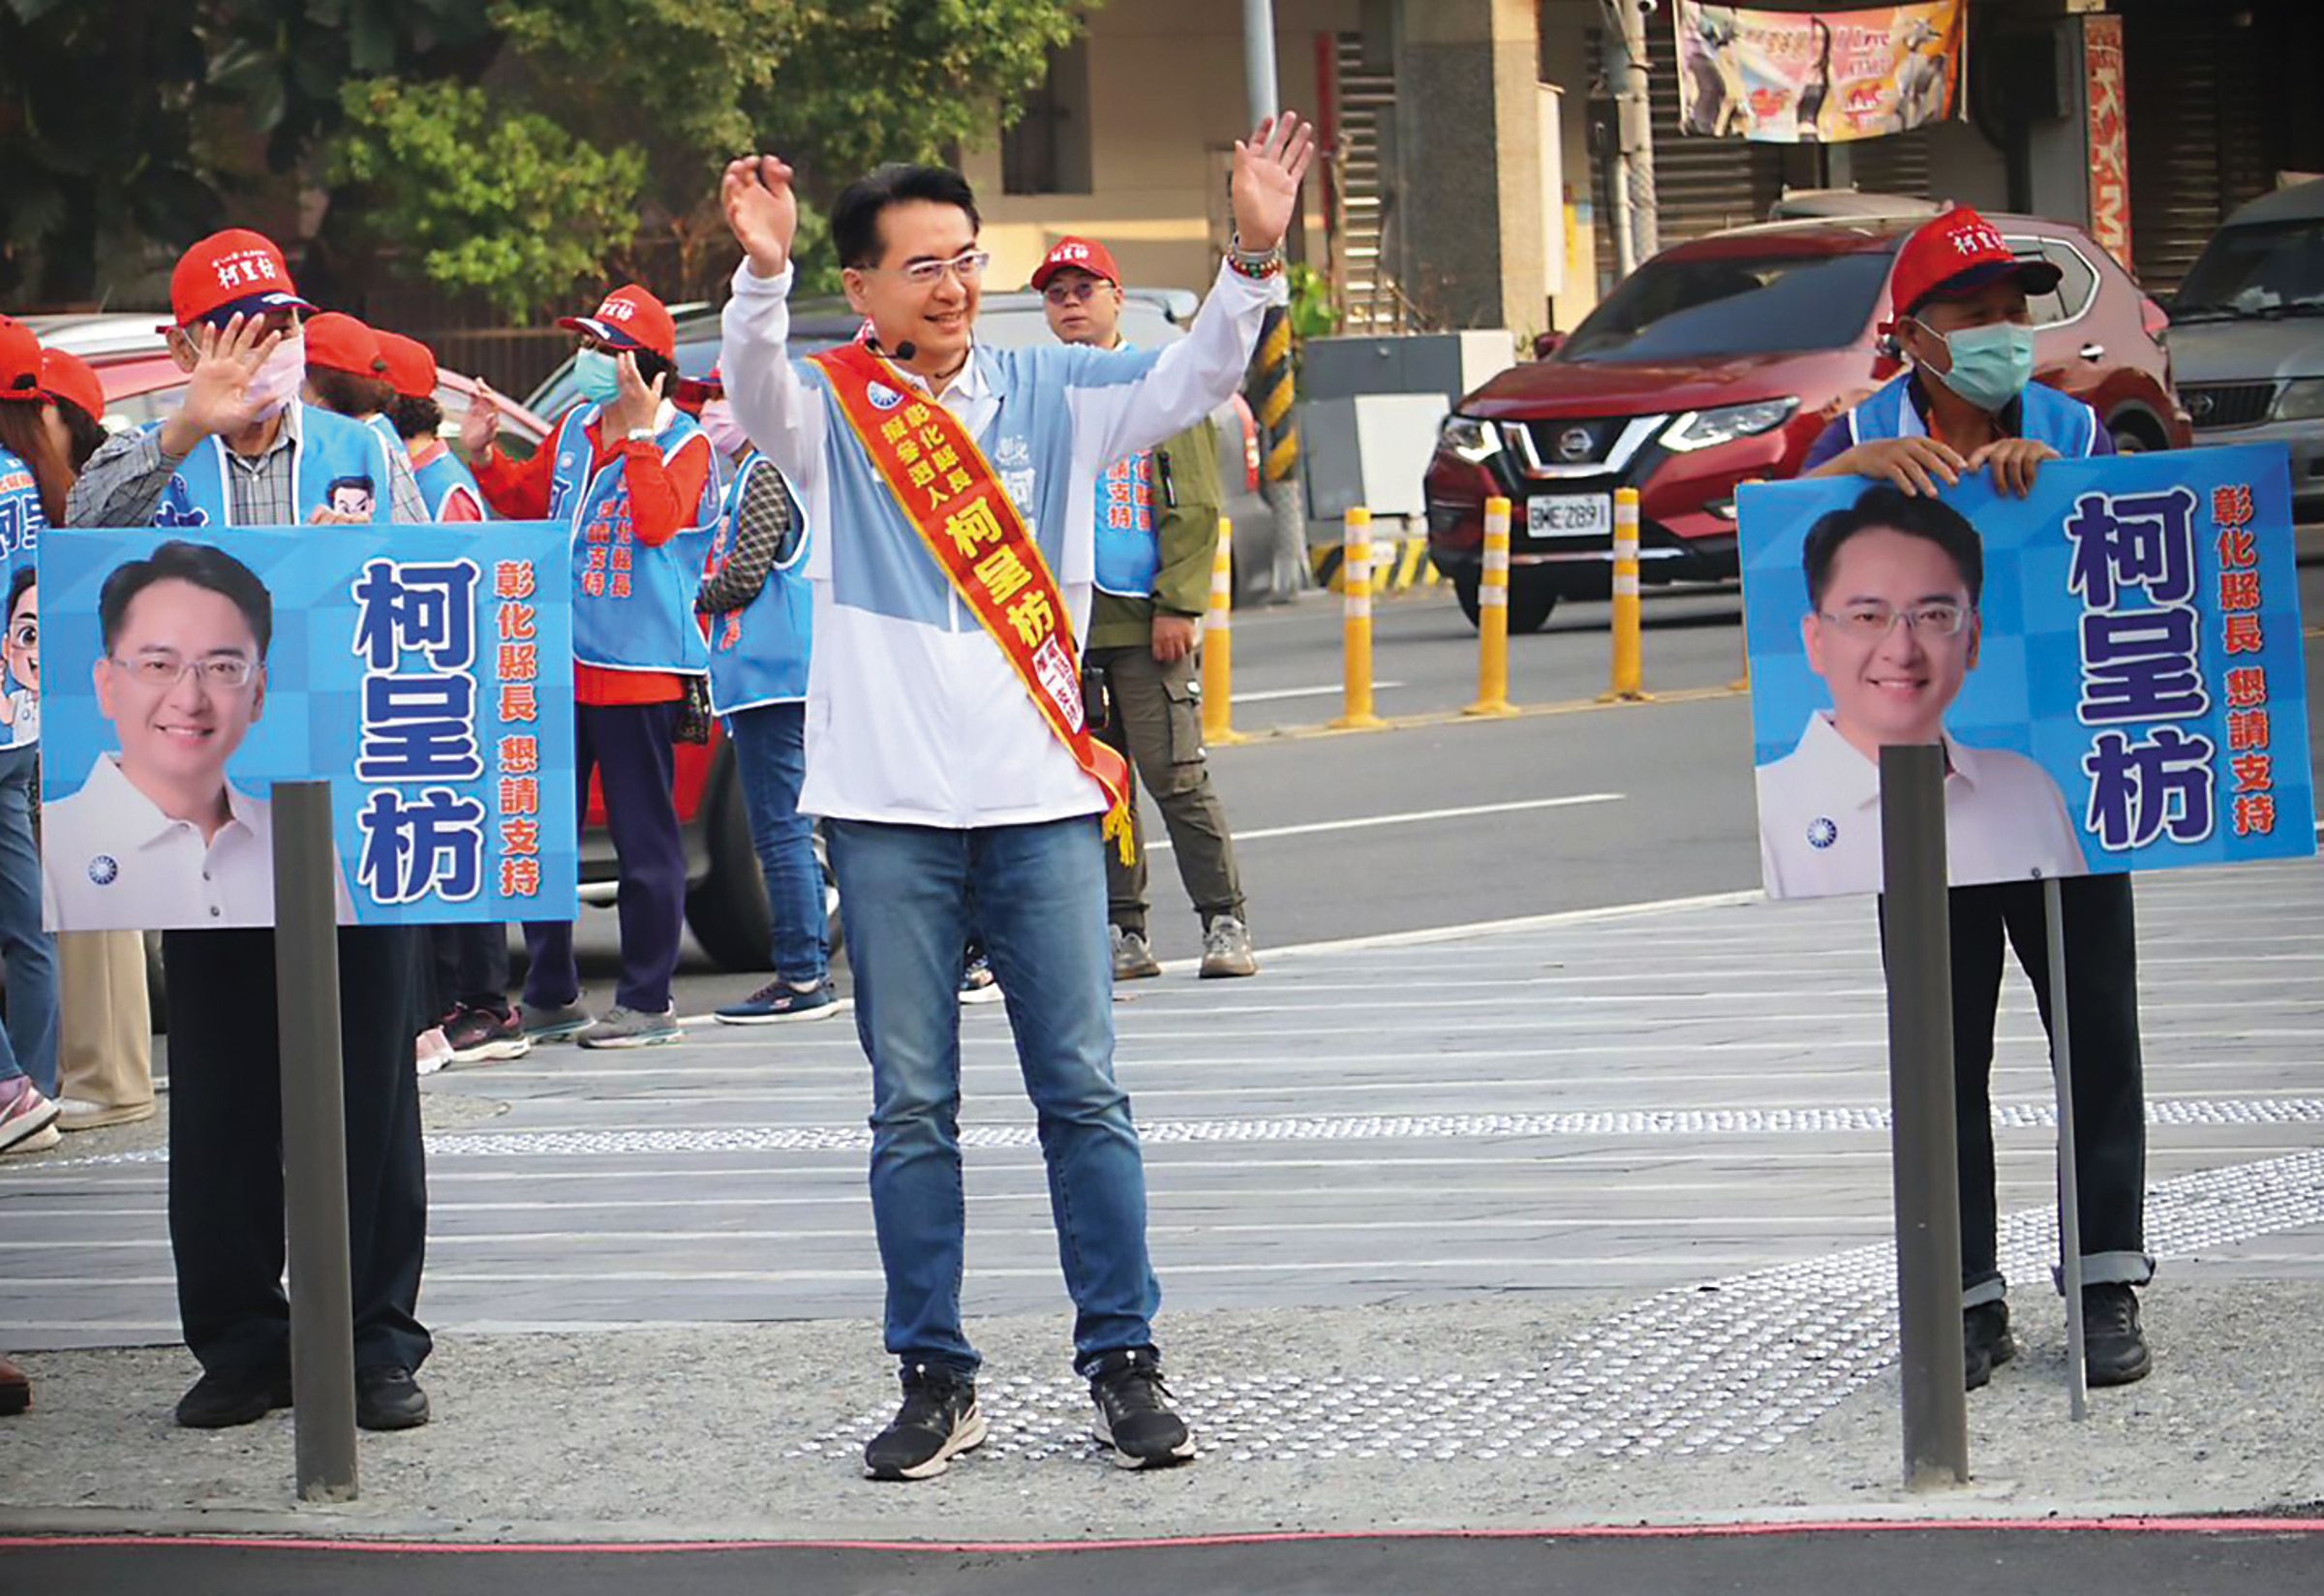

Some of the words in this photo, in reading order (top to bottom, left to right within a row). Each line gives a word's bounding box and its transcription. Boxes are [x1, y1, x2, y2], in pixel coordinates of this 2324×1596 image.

[2094, 67, 2125, 267] KYM
[495, 559, 536, 723] 彰化縣長
[945, 496, 1055, 649] 柯呈枋
[2211, 484, 2264, 656] 彰化縣長
[352, 556, 486, 905] 柯呈枋
[2064, 486, 2215, 850] 柯呈枋
[2224, 665, 2276, 835] 懇請支持
[499, 734, 541, 899] 懇請支持
